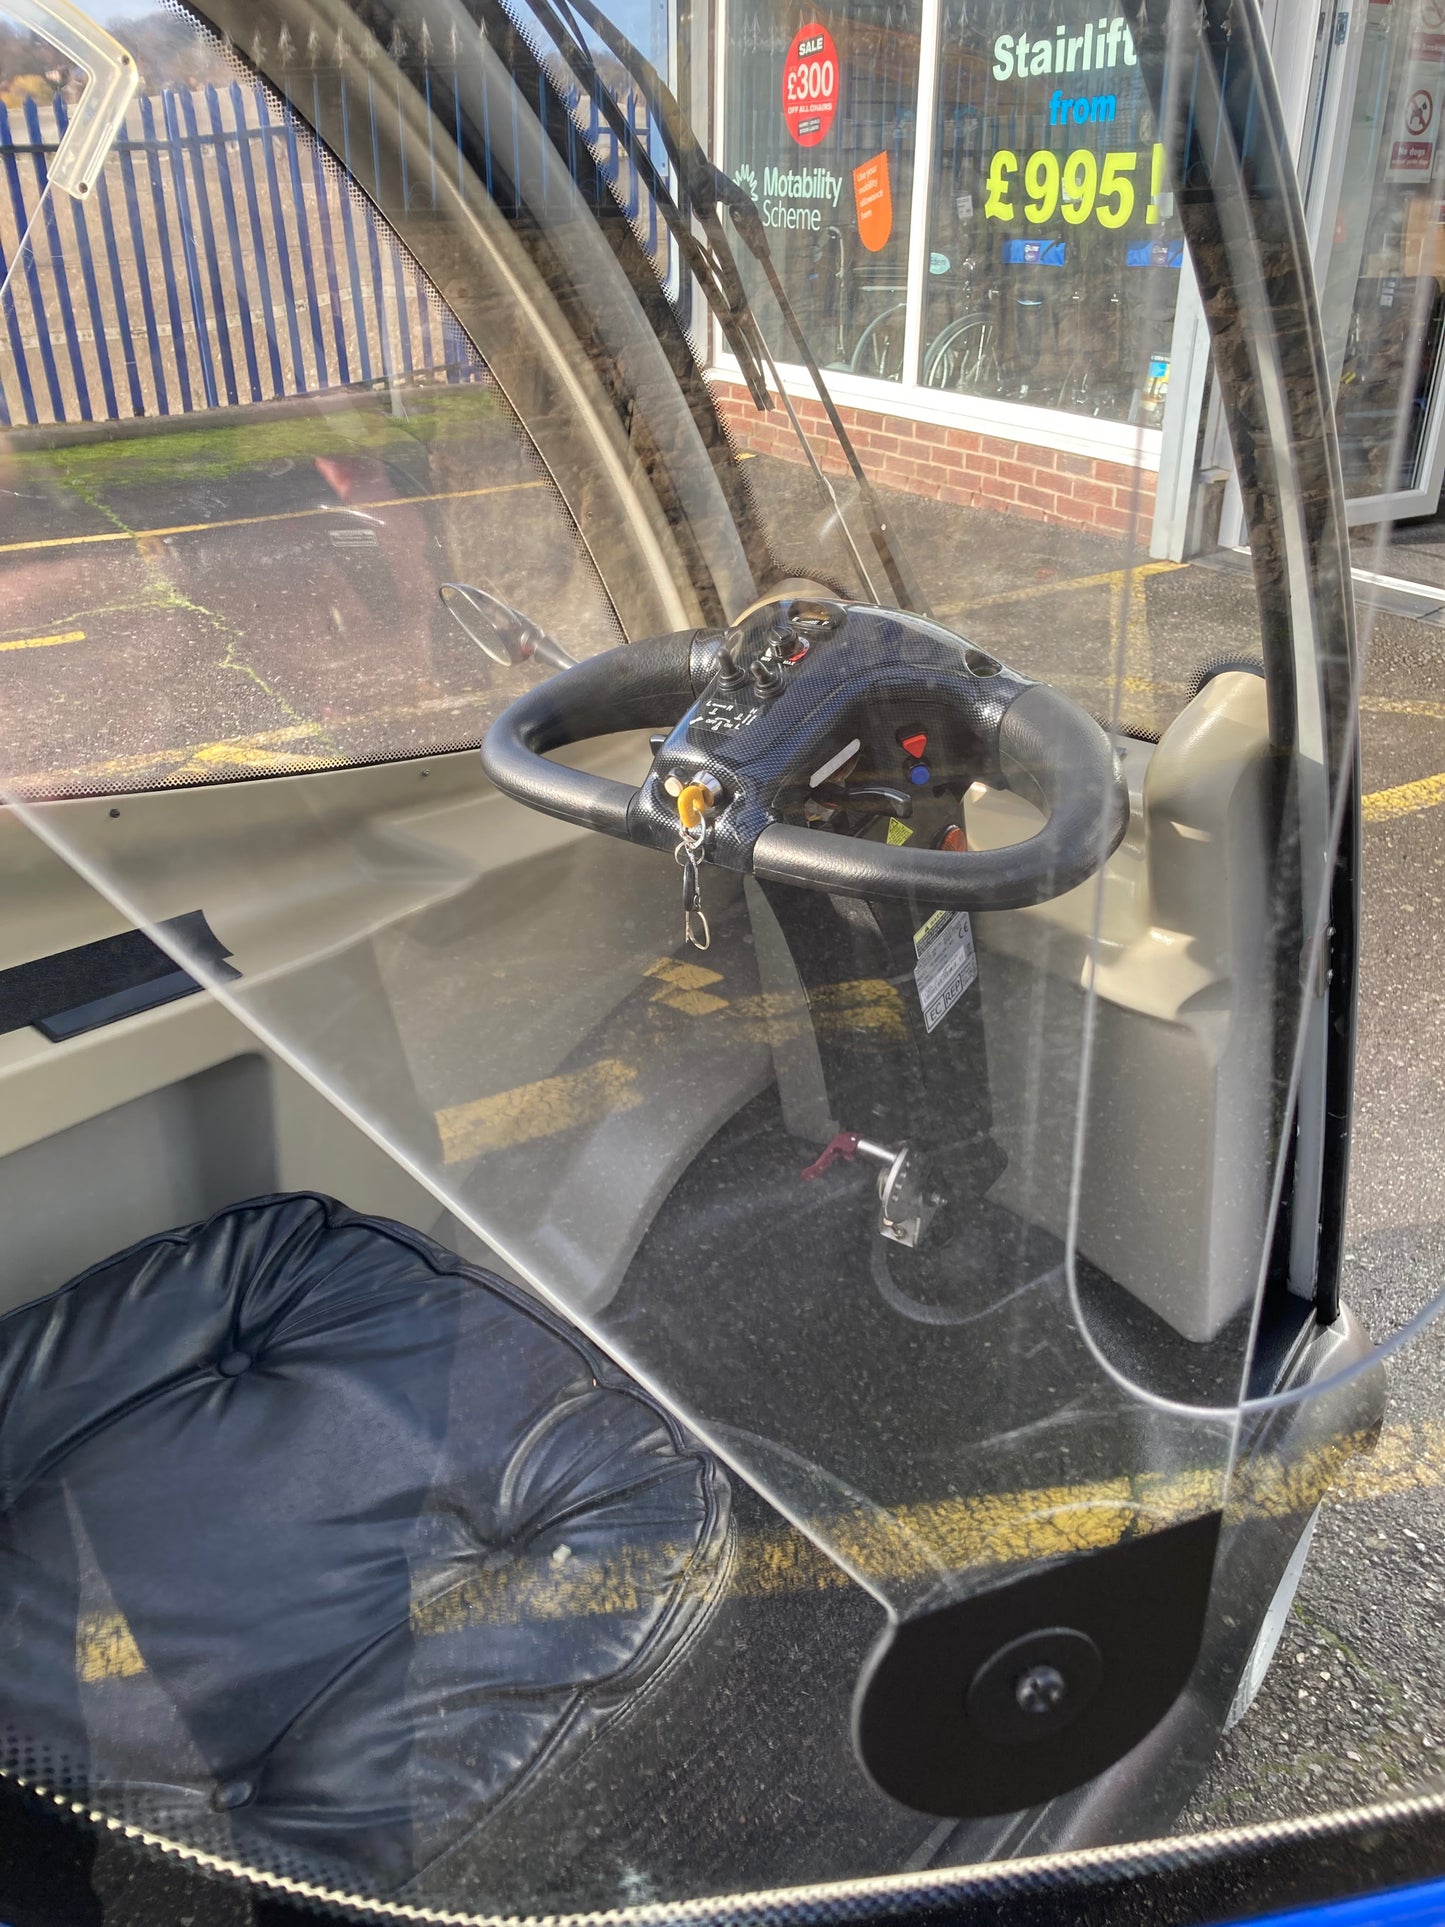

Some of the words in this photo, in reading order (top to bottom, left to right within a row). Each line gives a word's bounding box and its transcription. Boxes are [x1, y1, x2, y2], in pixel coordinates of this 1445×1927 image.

[798, 37, 824, 56] SALE
[787, 60, 834, 100] £300
[787, 106, 799, 115] OFF
[799, 104, 810, 113] ALL
[810, 102, 833, 113] CHAIRS
[1050, 89, 1117, 126] from
[763, 166, 843, 207] Motability
[762, 199, 822, 231] Scheme
[929, 1002, 943, 1022] EC
[944, 979, 960, 1005] REP
